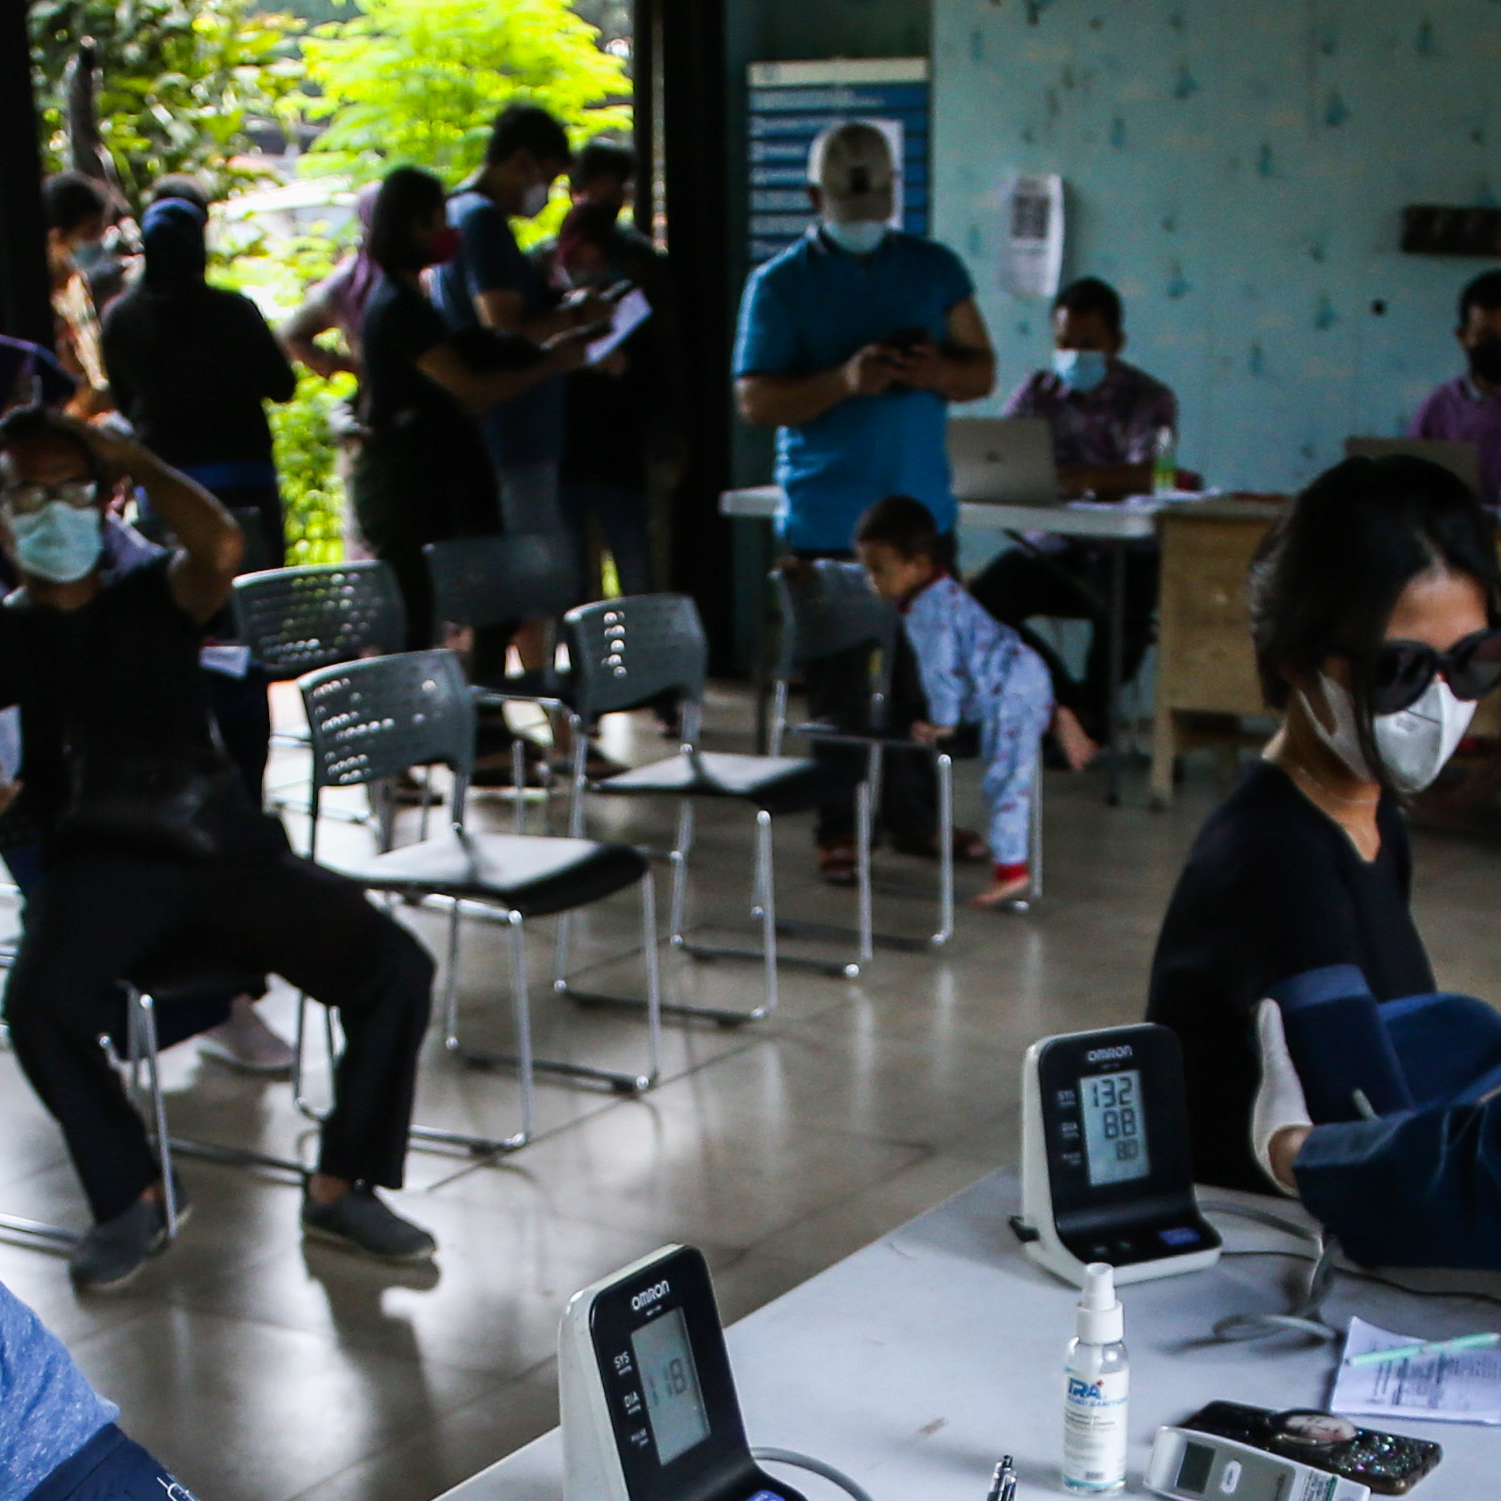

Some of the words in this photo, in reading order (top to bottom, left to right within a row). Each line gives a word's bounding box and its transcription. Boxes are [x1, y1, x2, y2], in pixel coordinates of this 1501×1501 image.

[1087, 1045, 1133, 1062] OMRON
[1092, 1076, 1133, 1108] 132
[1103, 1107, 1137, 1139] 88
[631, 1280, 671, 1311] OMRON
[614, 1351, 631, 1369] SYS
